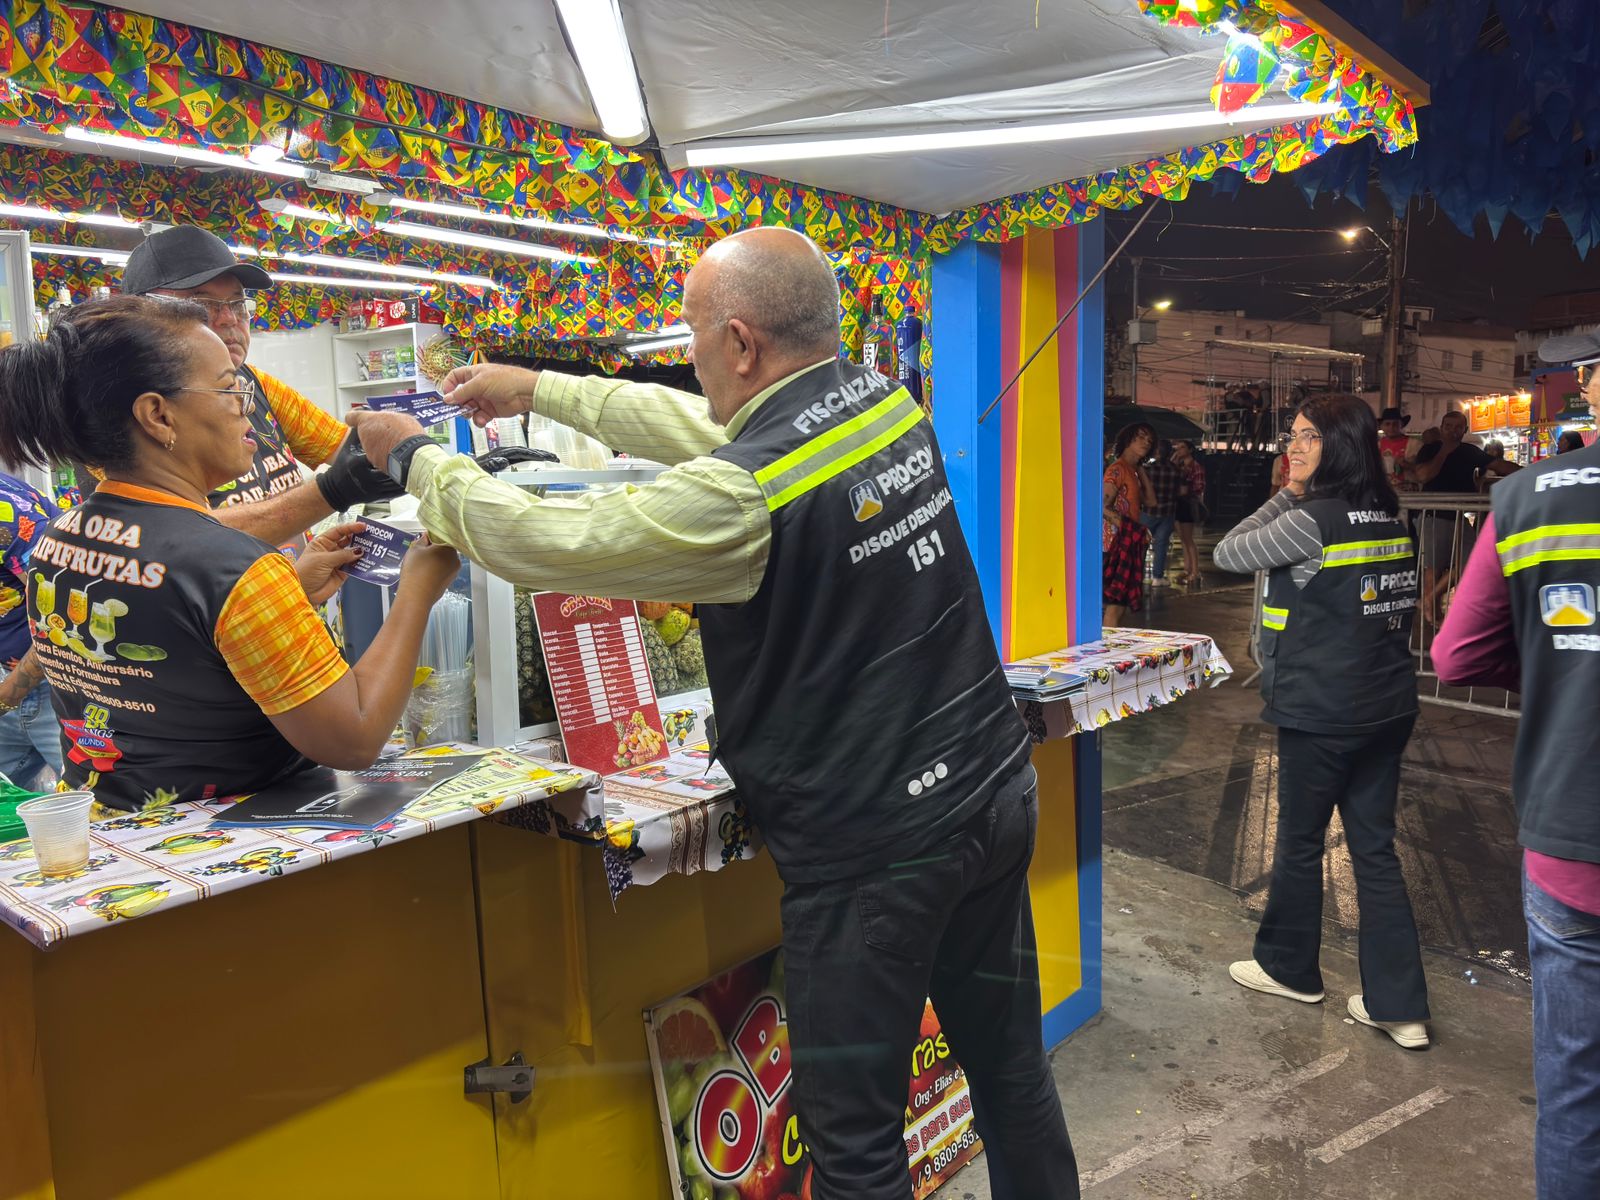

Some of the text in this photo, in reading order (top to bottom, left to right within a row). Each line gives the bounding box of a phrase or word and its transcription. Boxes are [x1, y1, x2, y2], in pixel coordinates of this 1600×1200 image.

[897, 337, 905, 380] BEATS
[262, 452, 289, 475] BA
[84, 514, 141, 549] OBA
[365, 524, 395, 541] PROCON
[849, 487, 953, 565] DISQUE DENÚNCIA
[31, 534, 166, 589] AIPIFRUTAS
[371, 543, 388, 559] 151
[906, 529, 946, 572] 151
[1363, 601, 1390, 616] DISQUE
[1387, 614, 1404, 631] 151
[36, 641, 154, 680] para Eventos, Aniversário
[65, 664, 71, 673] e
[70, 664, 121, 686] Formatura
[78, 737, 106, 748] MUNDO
[694, 995, 794, 1182] OB
[914, 1070, 960, 1108] Org: Elias e
[920, 1111, 949, 1151] para
[948, 1095, 971, 1123] sua
